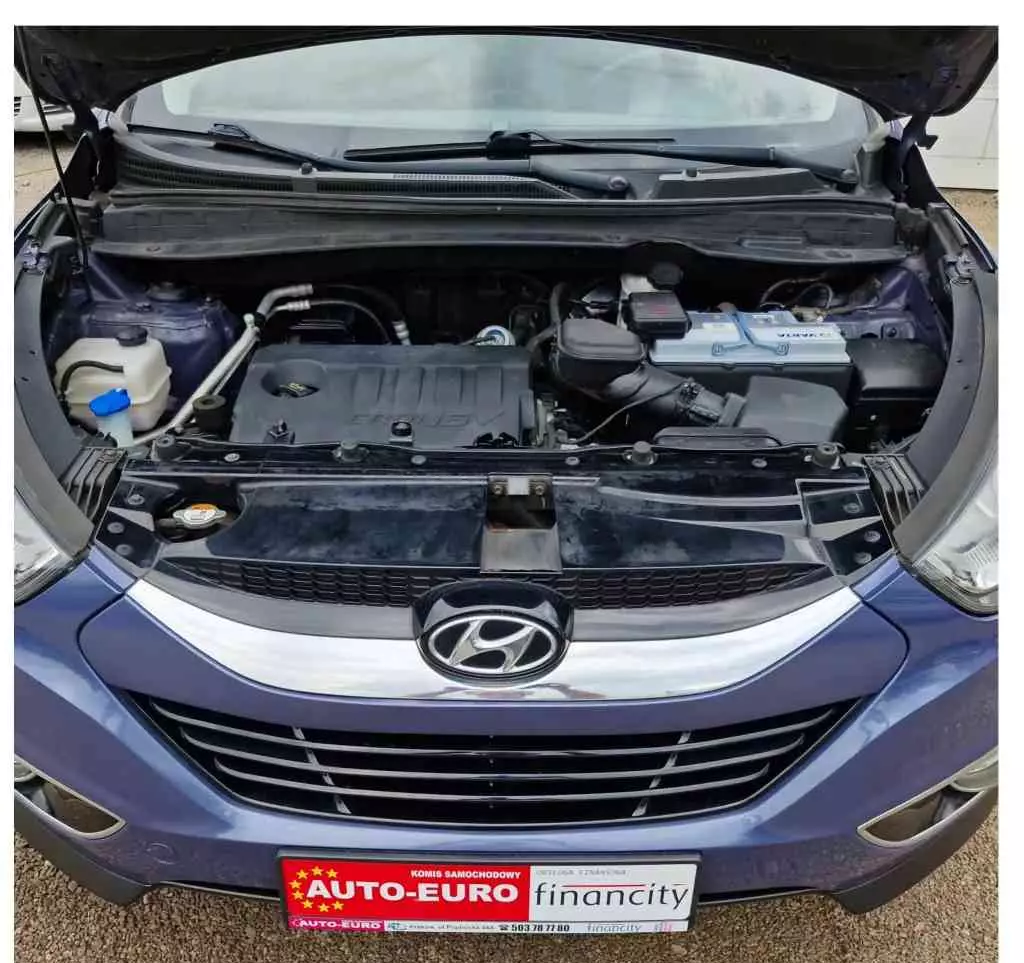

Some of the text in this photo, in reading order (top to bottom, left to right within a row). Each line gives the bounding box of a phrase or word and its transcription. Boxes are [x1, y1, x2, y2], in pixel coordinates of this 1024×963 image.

[410, 869, 522, 879] KOMIS SAMOCHODOWY
[306, 879, 519, 903] AUTO-EURO
[535, 882, 689, 910] financity
